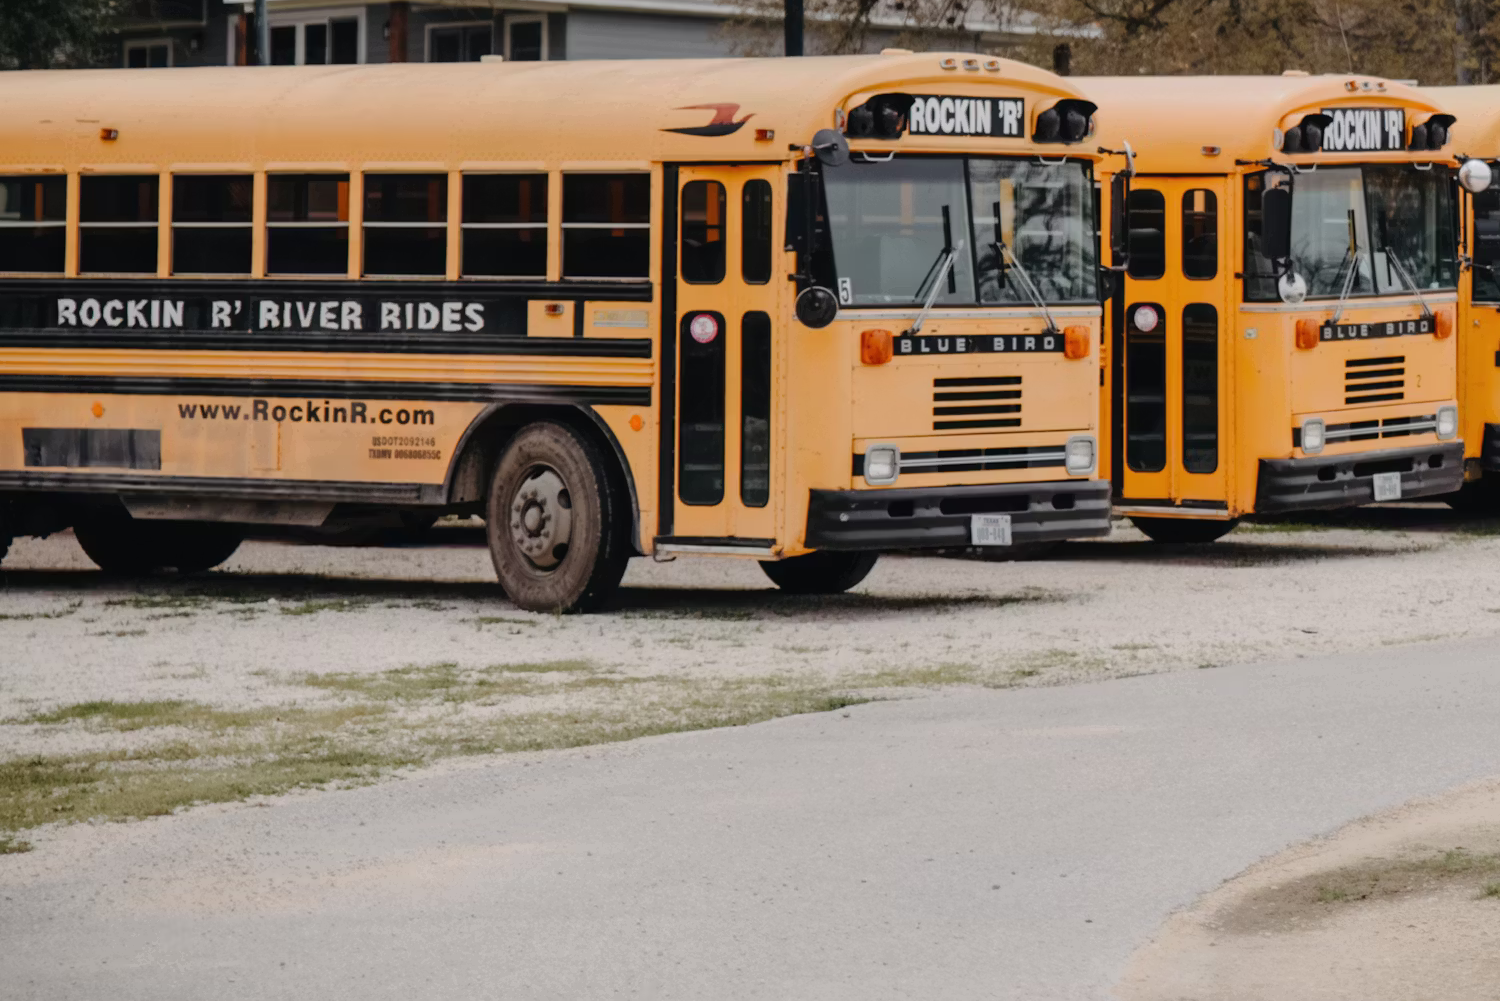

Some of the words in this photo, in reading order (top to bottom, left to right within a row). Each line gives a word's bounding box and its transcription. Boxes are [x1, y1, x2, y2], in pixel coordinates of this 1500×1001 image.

[910, 97, 991, 134] ROCKIN
[840, 280, 850, 303] 5
[57, 298, 184, 328] ROCKIN
[259, 300, 363, 330] RIVER
[381, 302, 485, 332] RIDES
[1323, 324, 1368, 339] BLUE
[1386, 320, 1429, 335] BIRD
[900, 338, 967, 354] BLUE
[993, 337, 1055, 351] BIRD
[178, 399, 435, 425] www.RockinR.com
[372, 436, 436, 447] USDOT2092146
